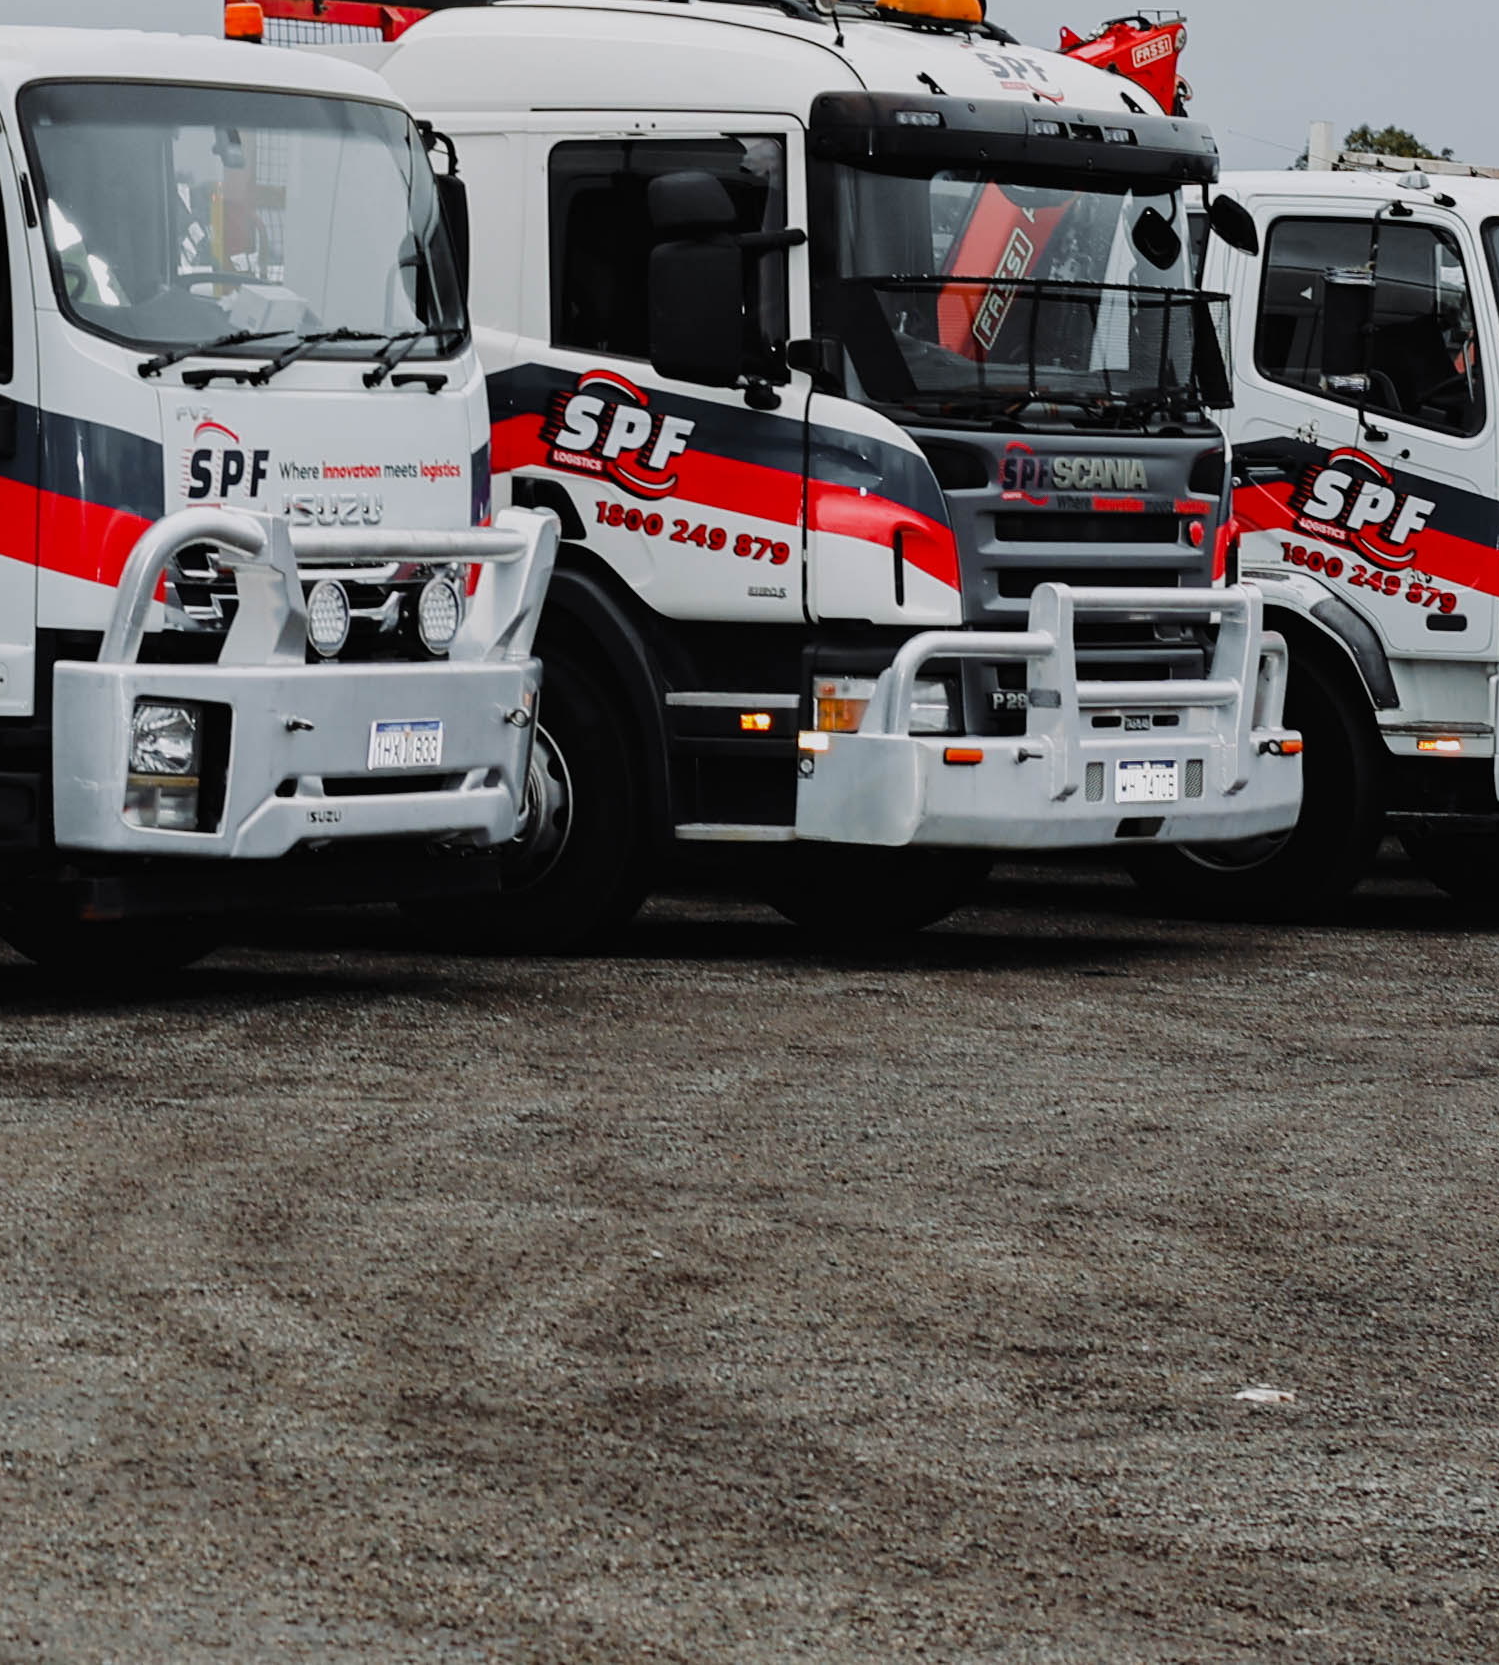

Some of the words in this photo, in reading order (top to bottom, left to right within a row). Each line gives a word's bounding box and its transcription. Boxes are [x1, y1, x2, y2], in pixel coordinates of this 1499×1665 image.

[1134, 38, 1171, 63] FASSI
[555, 394, 696, 470] SPF
[188, 449, 270, 499] SPF
[279, 462, 320, 480] Where
[322, 461, 382, 479] innovation
[384, 464, 418, 479] meets
[420, 460, 461, 482] logistics
[553, 449, 603, 472] LOGISTICS
[1052, 456, 1149, 490] SCANIA
[281, 493, 383, 527] ISUZU
[1302, 469, 1436, 545] SPF
[596, 500, 664, 536] 1800
[670, 519, 727, 551] 249
[734, 533, 790, 565] 879
[1299, 518, 1347, 542] LOGISTICS
[1280, 541, 1344, 578] 1800
[1348, 564, 1402, 596] 249
[1405, 582, 1458, 614] 879
[992, 692, 1004, 710] P
[1006, 692, 1028, 710] 28
[306, 810, 342, 823] ISUZU
